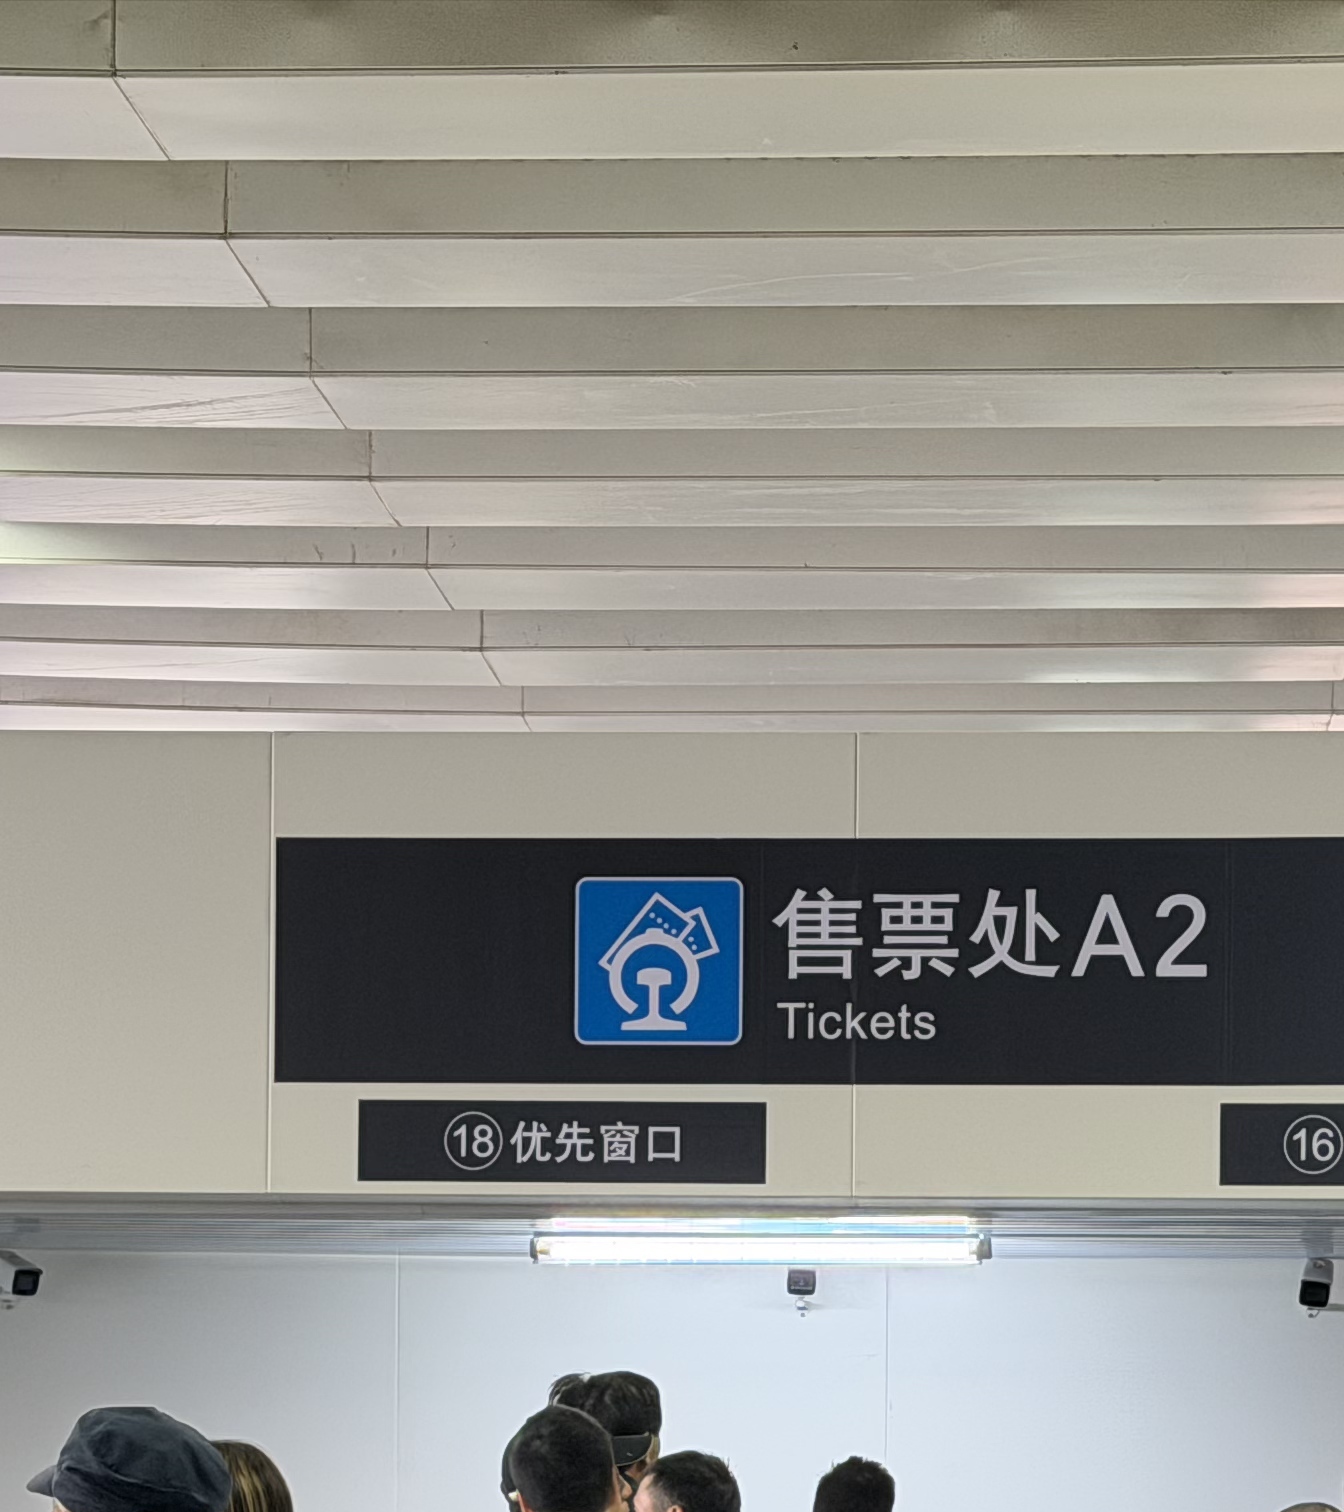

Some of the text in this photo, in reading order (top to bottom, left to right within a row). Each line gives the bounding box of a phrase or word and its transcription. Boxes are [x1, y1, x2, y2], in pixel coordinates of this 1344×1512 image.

[772, 887, 1209, 981] 售票处A2
[776, 1002, 936, 1040] Tickets
